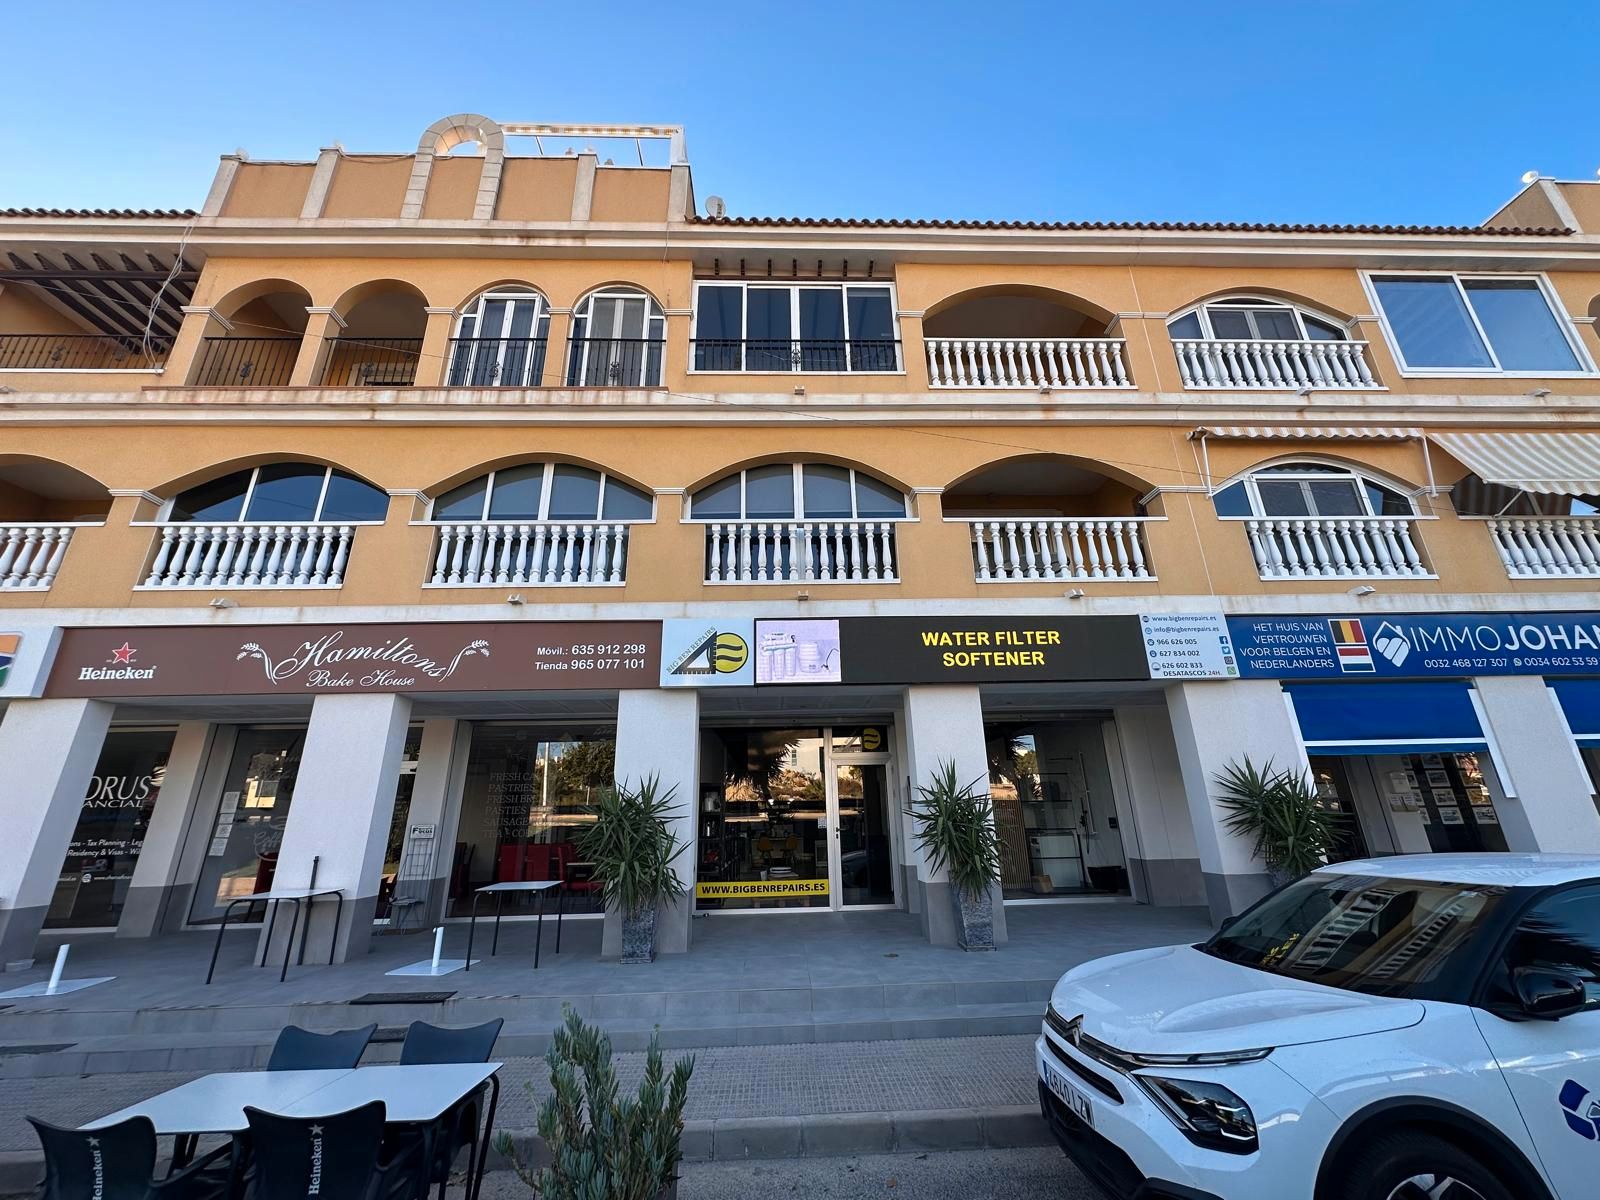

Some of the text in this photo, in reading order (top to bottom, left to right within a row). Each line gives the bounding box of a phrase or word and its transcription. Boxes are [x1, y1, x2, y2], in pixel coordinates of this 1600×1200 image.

[1252, 622, 1324, 632] HET HUIS VAN
[921, 630, 1061, 647] WATER FILTER
[1252, 634, 1328, 644] VERTROUWEN
[1410, 625, 1501, 652] IMMO
[571, 644, 595, 655] 635
[597, 644, 620, 655] 912
[623, 643, 646, 655] 298
[666, 626, 716, 673] BIG BEN REPAIRS
[1239, 646, 1331, 657] VOOR BELGEN EN
[273, 630, 447, 680] Hamiltons
[943, 651, 1045, 667] SOFTENER
[535, 658, 646, 670] Tienda 965 077 101
[1250, 658, 1335, 669] NEDERLANDERS
[1424, 656, 1599, 668] 0032 468 127 307 0034 602 53 59
[78, 666, 154, 681] Heineken
[306, 669, 415, 688] Bake House
[490, 772, 521, 781] FRESH
[488, 783, 536, 793] PASTRIES
[486, 794, 518, 804] FRESH
[485, 805, 527, 816] PASTIES
[98, 838, 126, 848] Planning
[67, 849, 99, 858] Residency
[100, 848, 106, 856] &
[107, 848, 124, 856] Visas
[701, 883, 825, 894] WWW.BIGBENREPAIRS.ES
[308, 1137, 323, 1195] Heineken
